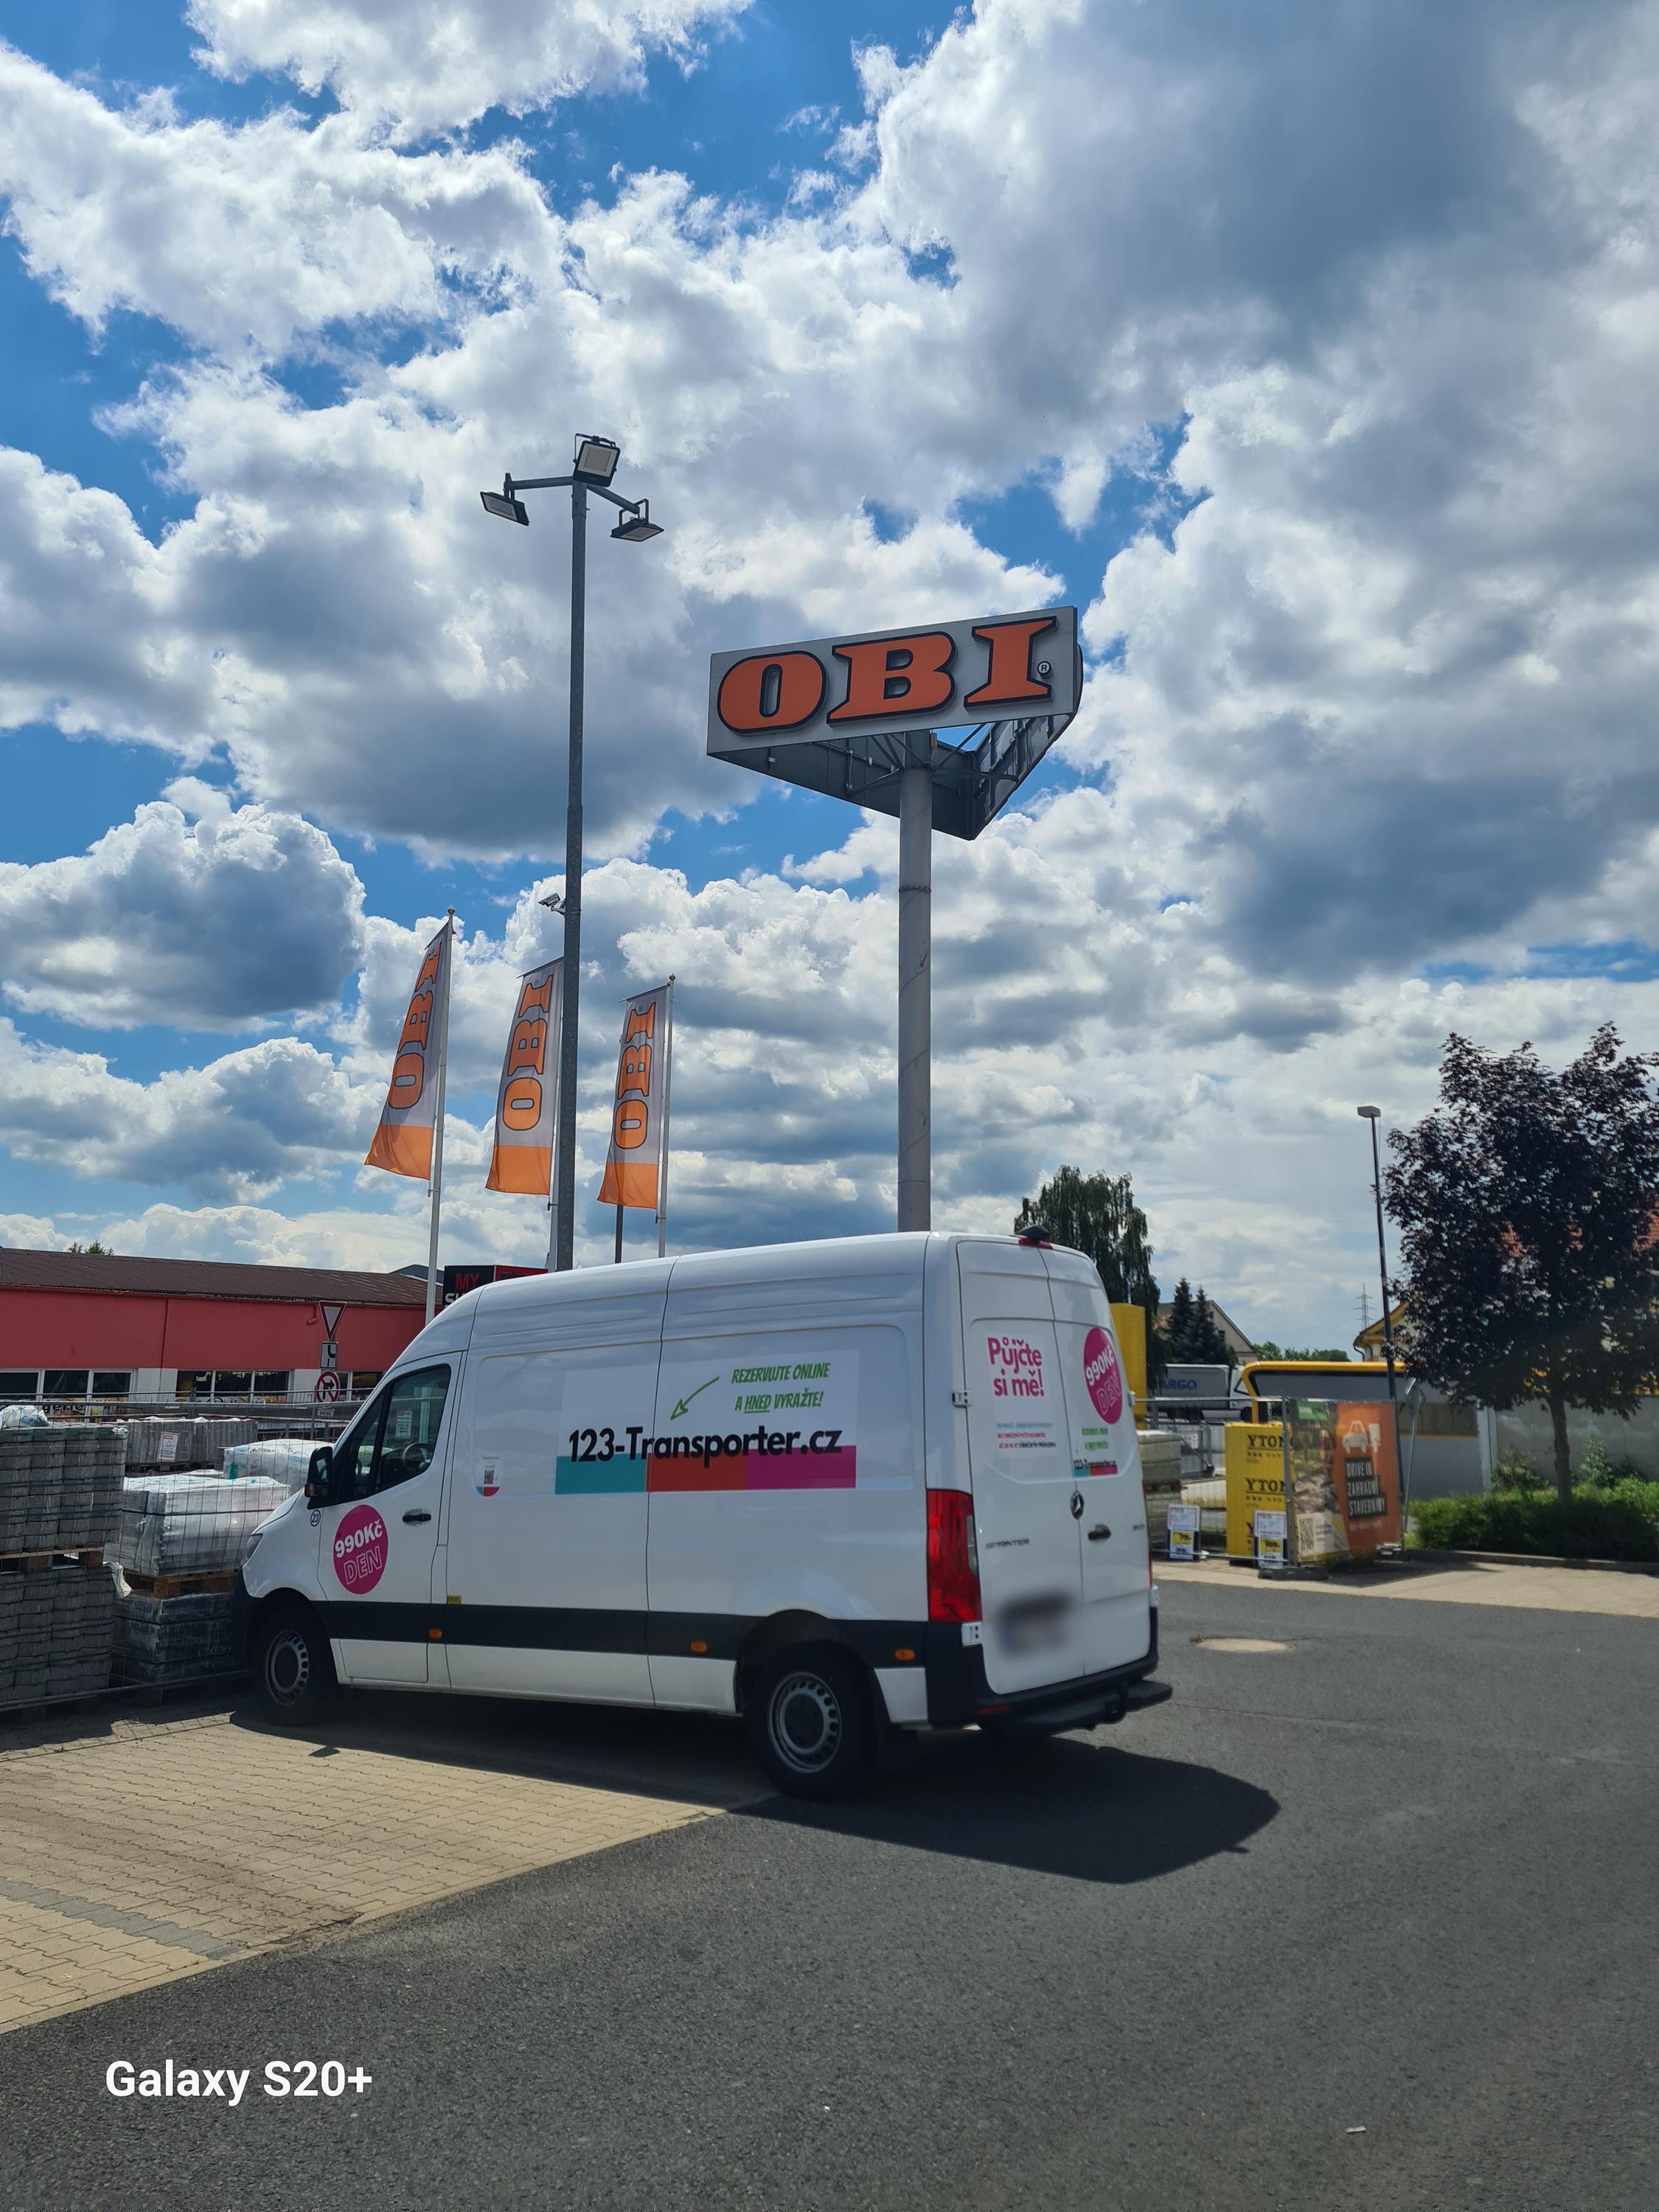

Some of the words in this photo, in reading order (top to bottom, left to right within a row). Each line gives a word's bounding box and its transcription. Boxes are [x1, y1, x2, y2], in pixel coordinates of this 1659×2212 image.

[717, 616, 1057, 734] OBI
[388, 941, 442, 1110] OBI
[502, 974, 554, 1131] OBI
[614, 1001, 656, 1150] OBI
[455, 1273, 480, 1291] MY
[731, 1365, 792, 1384] REZERVUJTE
[793, 1363, 831, 1380] ONLINE
[987, 1337, 1043, 1374] Půjčte
[1085, 1345, 1116, 1386] 990Kč
[734, 1396, 743, 1411] A
[744, 1394, 772, 1411] HNED
[773, 1388, 824, 1410] VYRAŽTE!
[993, 1368, 1008, 1397] si
[1012, 1368, 1045, 1397] mě!
[1096, 1371, 1122, 1415] DEN
[1160, 1380, 1199, 1391] ARGO
[569, 1425, 843, 1469] 123-Transporter.cz
[1346, 1462, 1365, 1478] DRIVE
[312, 1513, 319, 1523] 23
[1349, 1498, 1385, 1517] STAVEBNINY
[335, 1519, 383, 1558] 990Kč
[344, 1545, 383, 1585] DEN
